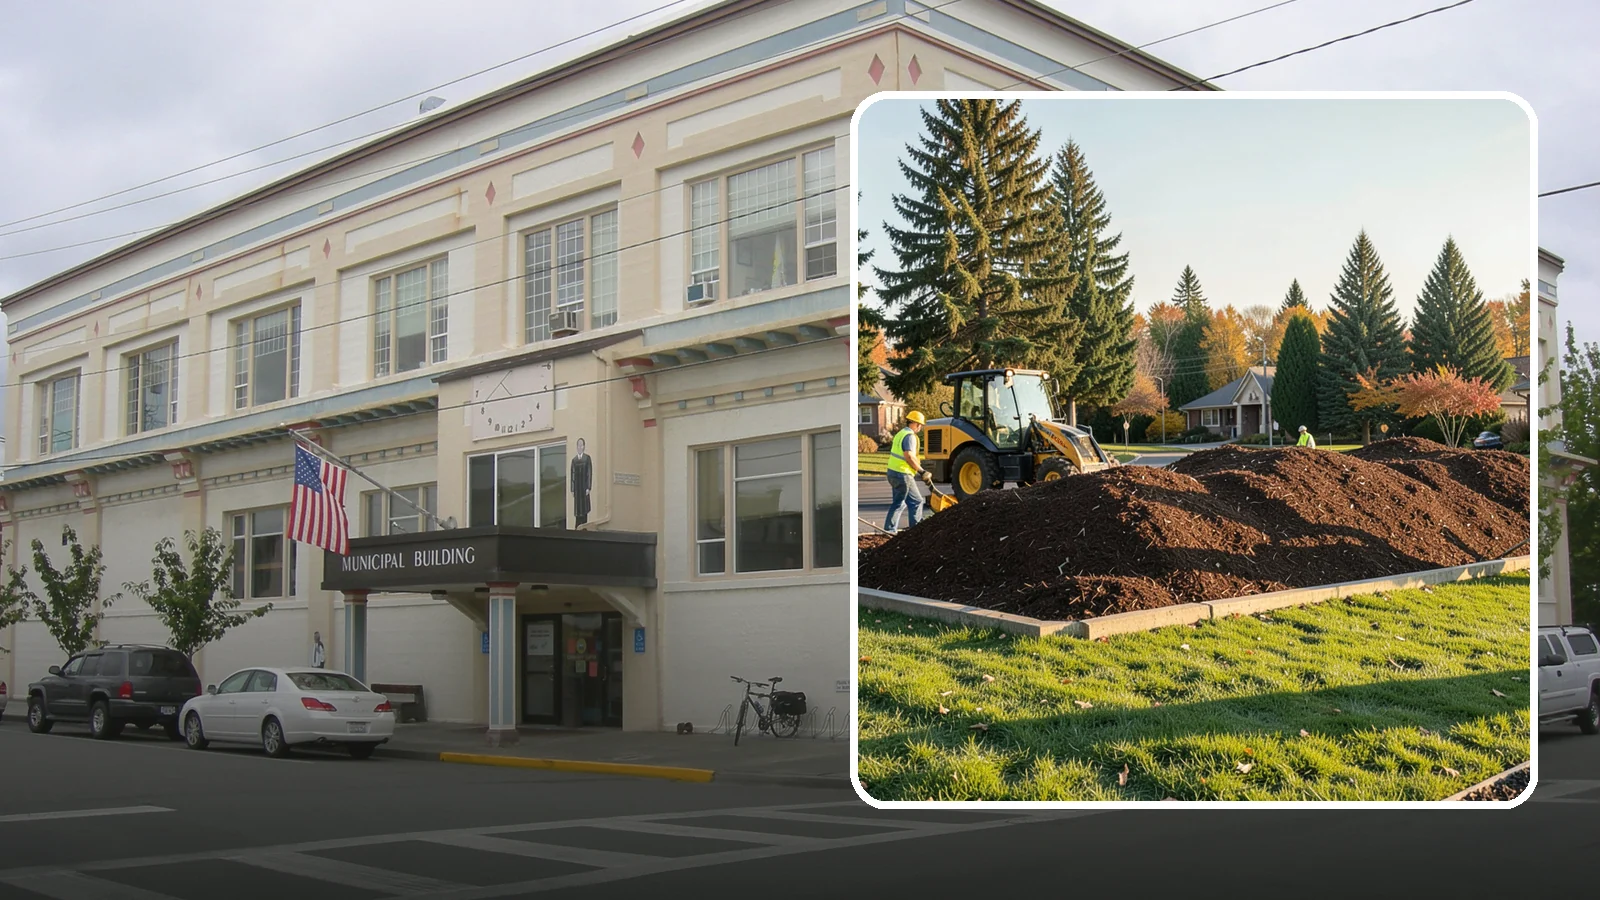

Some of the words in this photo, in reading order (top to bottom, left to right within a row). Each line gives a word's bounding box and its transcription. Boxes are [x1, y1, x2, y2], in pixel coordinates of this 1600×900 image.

[536, 402, 540, 410] 4
[481, 407, 485, 415] 8
[488, 418, 492, 426] 9
[529, 414, 533, 422] 3
[495, 424, 500, 432] 10
[521, 420, 525, 428] 2
[502, 426, 506, 434] 11
[507, 425, 513, 433] 12
[342, 552, 405, 572] MUNICIPAL
[414, 546, 475, 567] BUILDING
